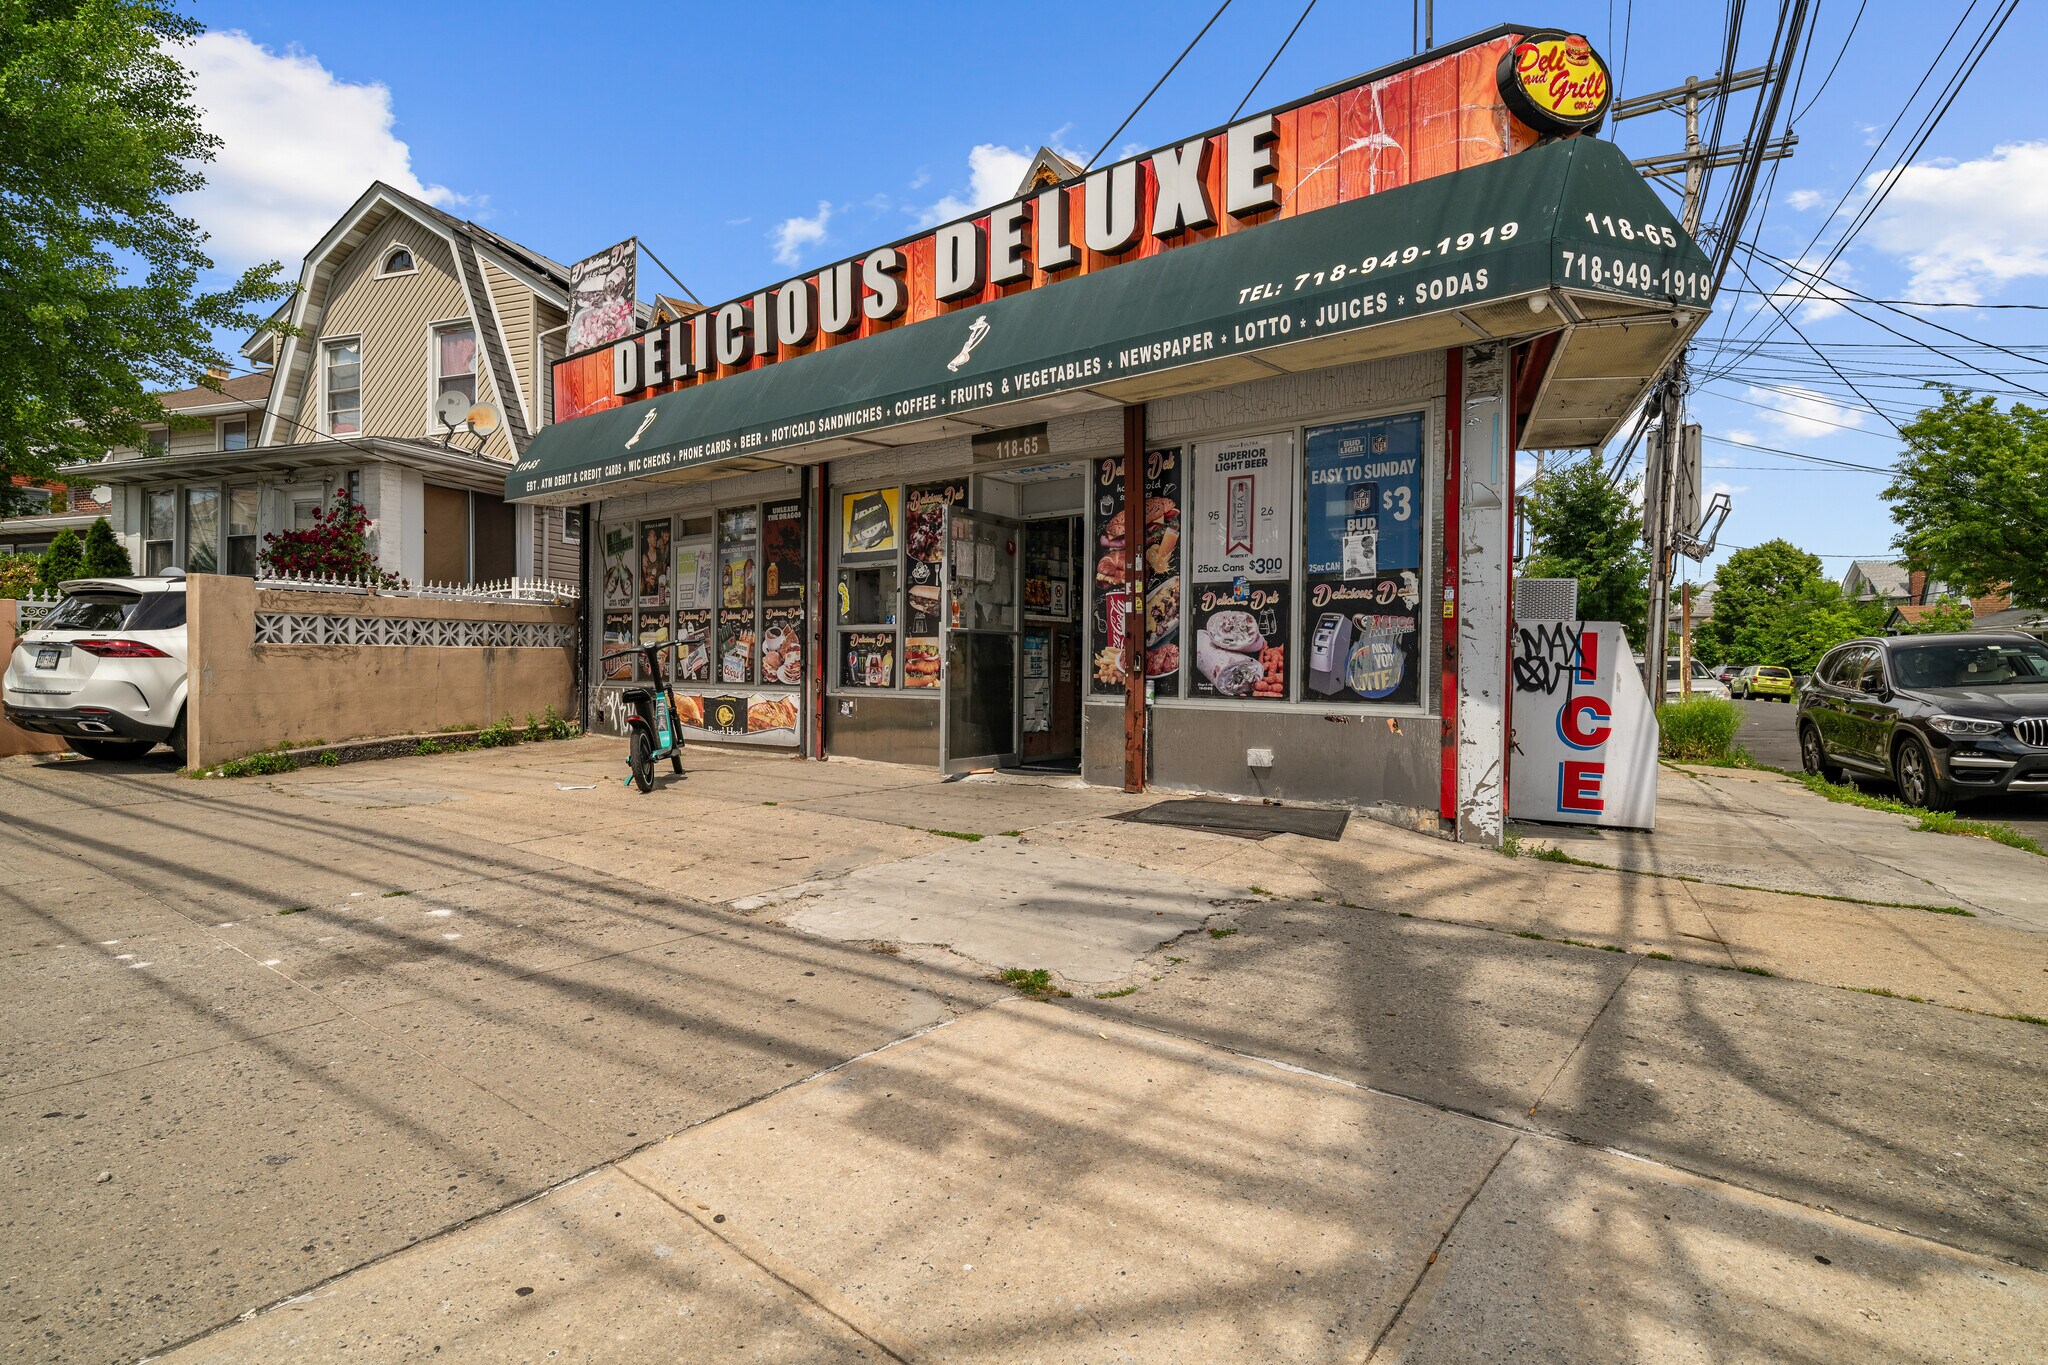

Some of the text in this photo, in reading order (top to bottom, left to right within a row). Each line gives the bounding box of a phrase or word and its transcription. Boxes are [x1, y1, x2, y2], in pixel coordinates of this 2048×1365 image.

[1515, 42, 1566, 73] Deli
[1523, 70, 1605, 111] and Grill
[1584, 212, 1677, 248] 118-65
[613, 113, 1280, 397] DELICIOUS DELUXE
[1237, 221, 1519, 305] TEL: 718-949-1919
[1562, 250, 1710, 300] 718-949-1919
[541, 478, 553, 489] ATM
[554, 475, 572, 487] DEBIT
[573, 472, 578, 482] &
[579, 467, 602, 480] CREDIT
[604, 463, 622, 477] CARDS
[628, 459, 642, 472] WIC
[643, 452, 671, 470] CHECKS
[678, 446, 704, 462] PHONE
[705, 439, 731, 455] CARDS
[740, 432, 762, 448] BEER
[771, 419, 816, 442] HOT/COLD
[818, 405, 883, 433] SANDWICHES
[895, 393, 936, 416] COFFEE
[950, 381, 993, 405] FRUITS
[1001, 377, 1010, 394] &
[1014, 356, 1101, 391] VEGETABLES
[1119, 331, 1214, 369] NEWSPAPER
[1235, 314, 1291, 344] LOTTO
[1315, 292, 1388, 327] JUICES
[1415, 268, 1489, 304] SODAS
[996, 436, 1039, 459] 118-65
[1218, 448, 1266, 462] SUPERIOR
[1340, 446, 1364, 454] LIGHT
[1343, 439, 1361, 448] BUD
[1373, 441, 1388, 451] NFL
[1215, 458, 1268, 472] LIGHT BEER
[1311, 459, 1416, 485] EASY TO SUNDAY
[772, 504, 798, 514] UNLEASH
[1237, 495, 1245, 528] ULTRA
[1260, 506, 1274, 516] 2.6
[1353, 496, 1371, 508] NFL
[1382, 486, 1412, 522] $3
[1208, 511, 1220, 521] 95
[1347, 517, 1377, 531] BUD
[1198, 564, 1220, 573] 25oz.
[1222, 563, 1245, 572] Cans
[1308, 561, 1341, 572] 25oz CAN
[1312, 580, 1411, 607] Delicious Del
[1519, 621, 1586, 665] MAX
[1555, 632, 1612, 816] ICE
